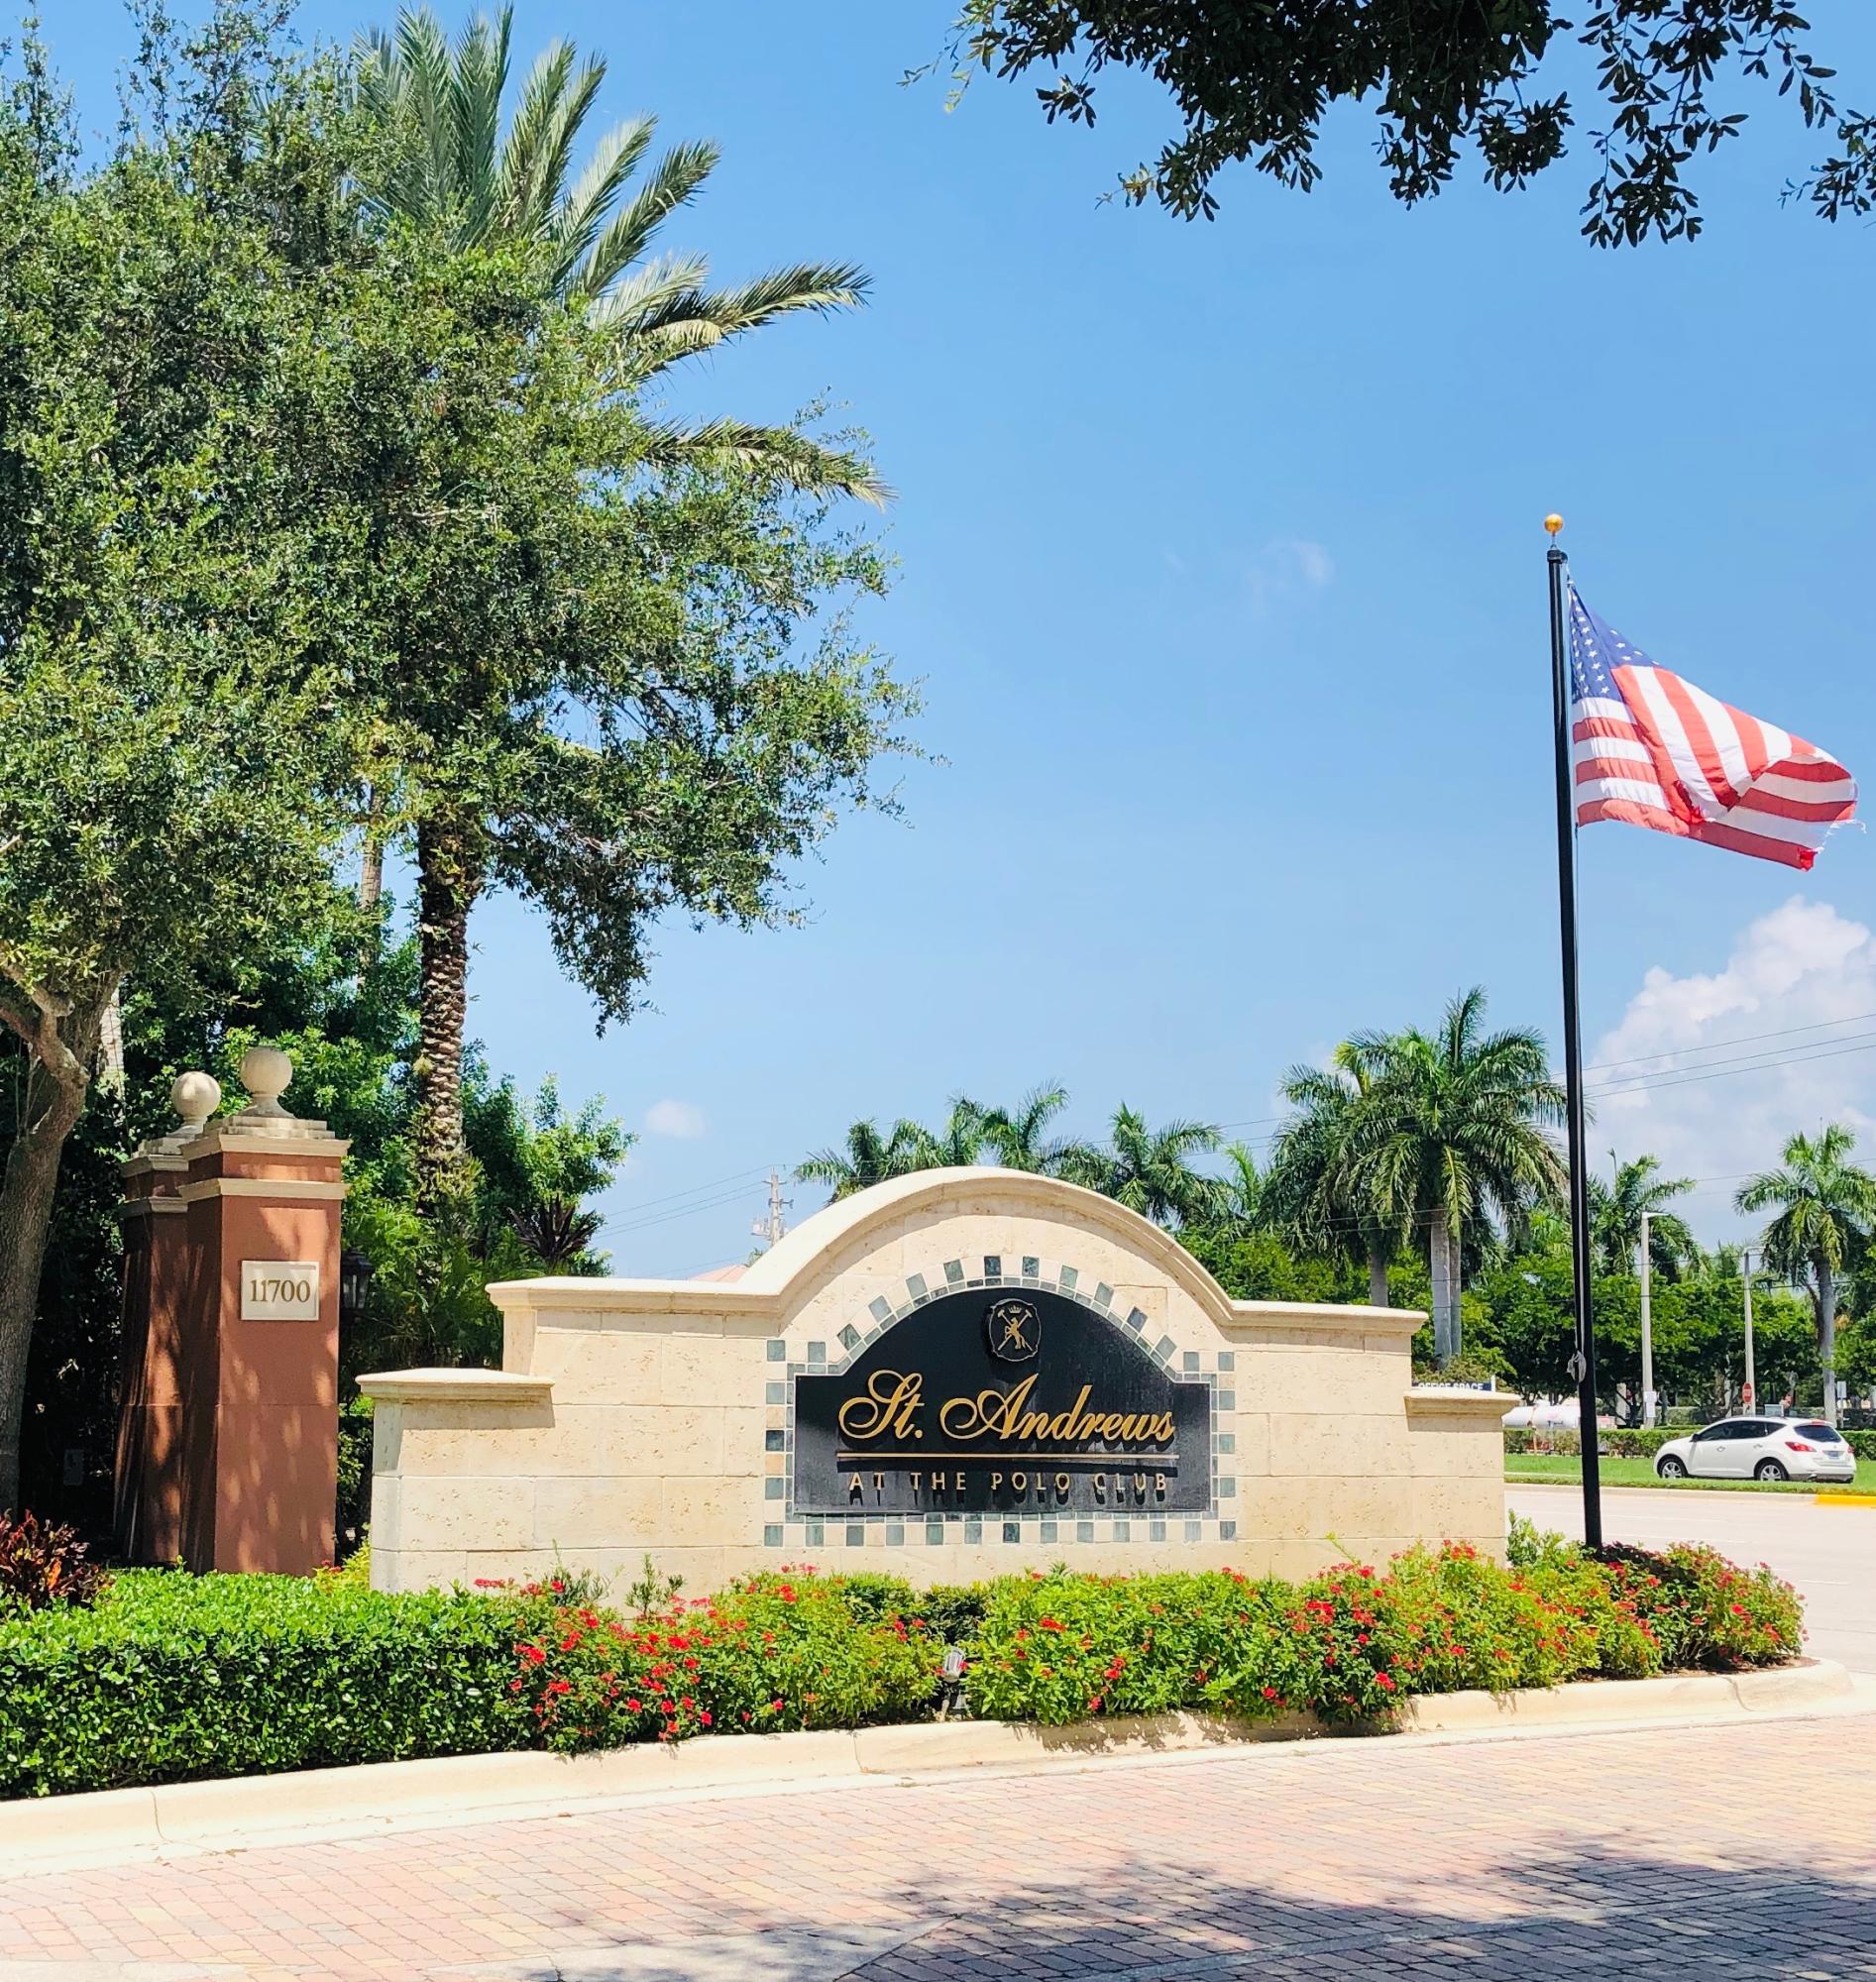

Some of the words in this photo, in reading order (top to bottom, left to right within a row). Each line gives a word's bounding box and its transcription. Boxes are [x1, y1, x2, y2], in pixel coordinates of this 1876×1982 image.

[250, 1279, 311, 1303] 11700
[838, 1369, 926, 1440] St.
[939, 1373, 1176, 1442] Andrews
[848, 1472, 886, 1491] AT
[910, 1472, 967, 1490] THE
[990, 1472, 1070, 1491] POLO
[1094, 1472, 1166, 1491] CLUB
